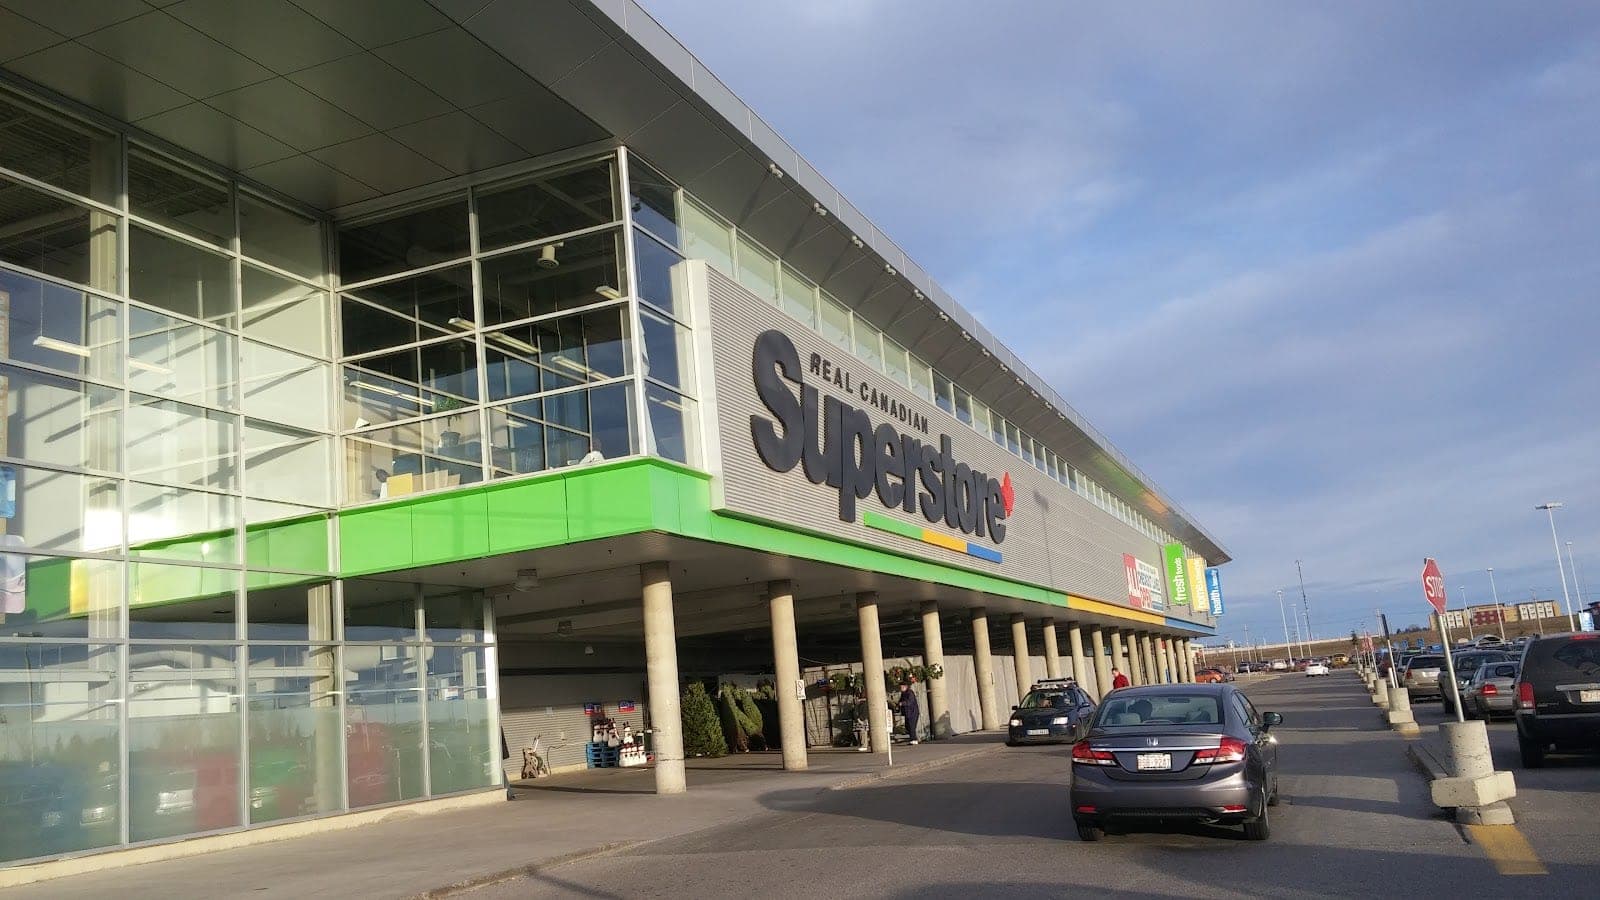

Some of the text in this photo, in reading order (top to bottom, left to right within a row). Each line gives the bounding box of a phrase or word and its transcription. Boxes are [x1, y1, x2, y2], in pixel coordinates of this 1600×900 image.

[810, 352, 929, 434] REAL CANADIAN
[750, 329, 1006, 544] Superstore
[1172, 573, 1187, 602] fresh
[1425, 575, 1444, 598] STOP
[1210, 589, 1223, 614] health
